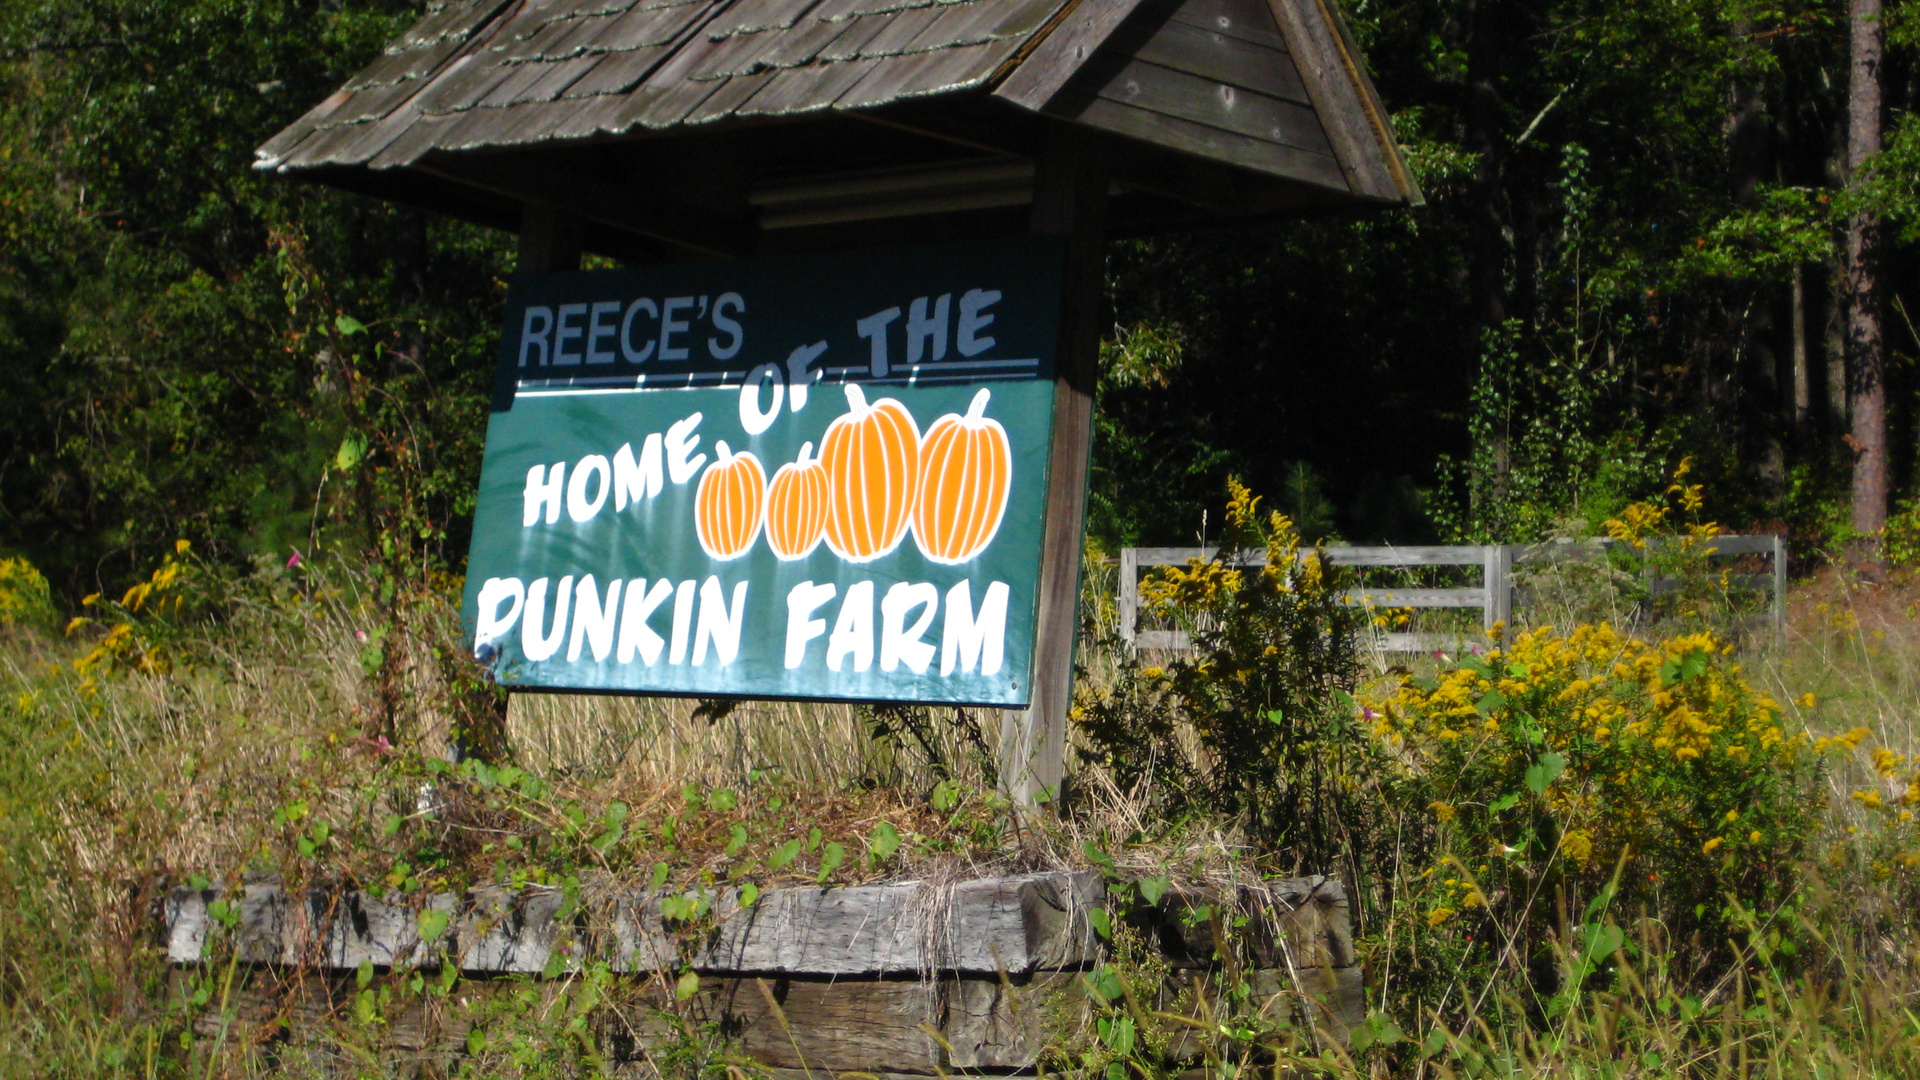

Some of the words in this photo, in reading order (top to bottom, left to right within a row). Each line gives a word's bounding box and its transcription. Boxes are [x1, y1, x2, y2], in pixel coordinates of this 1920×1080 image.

[518, 291, 746, 368] REECE'S
[523, 412, 707, 527] HOME
[738, 340, 828, 436] OF
[857, 288, 1002, 378] THE
[473, 573, 749, 667] PUNKIN
[784, 578, 1010, 677] FARM
